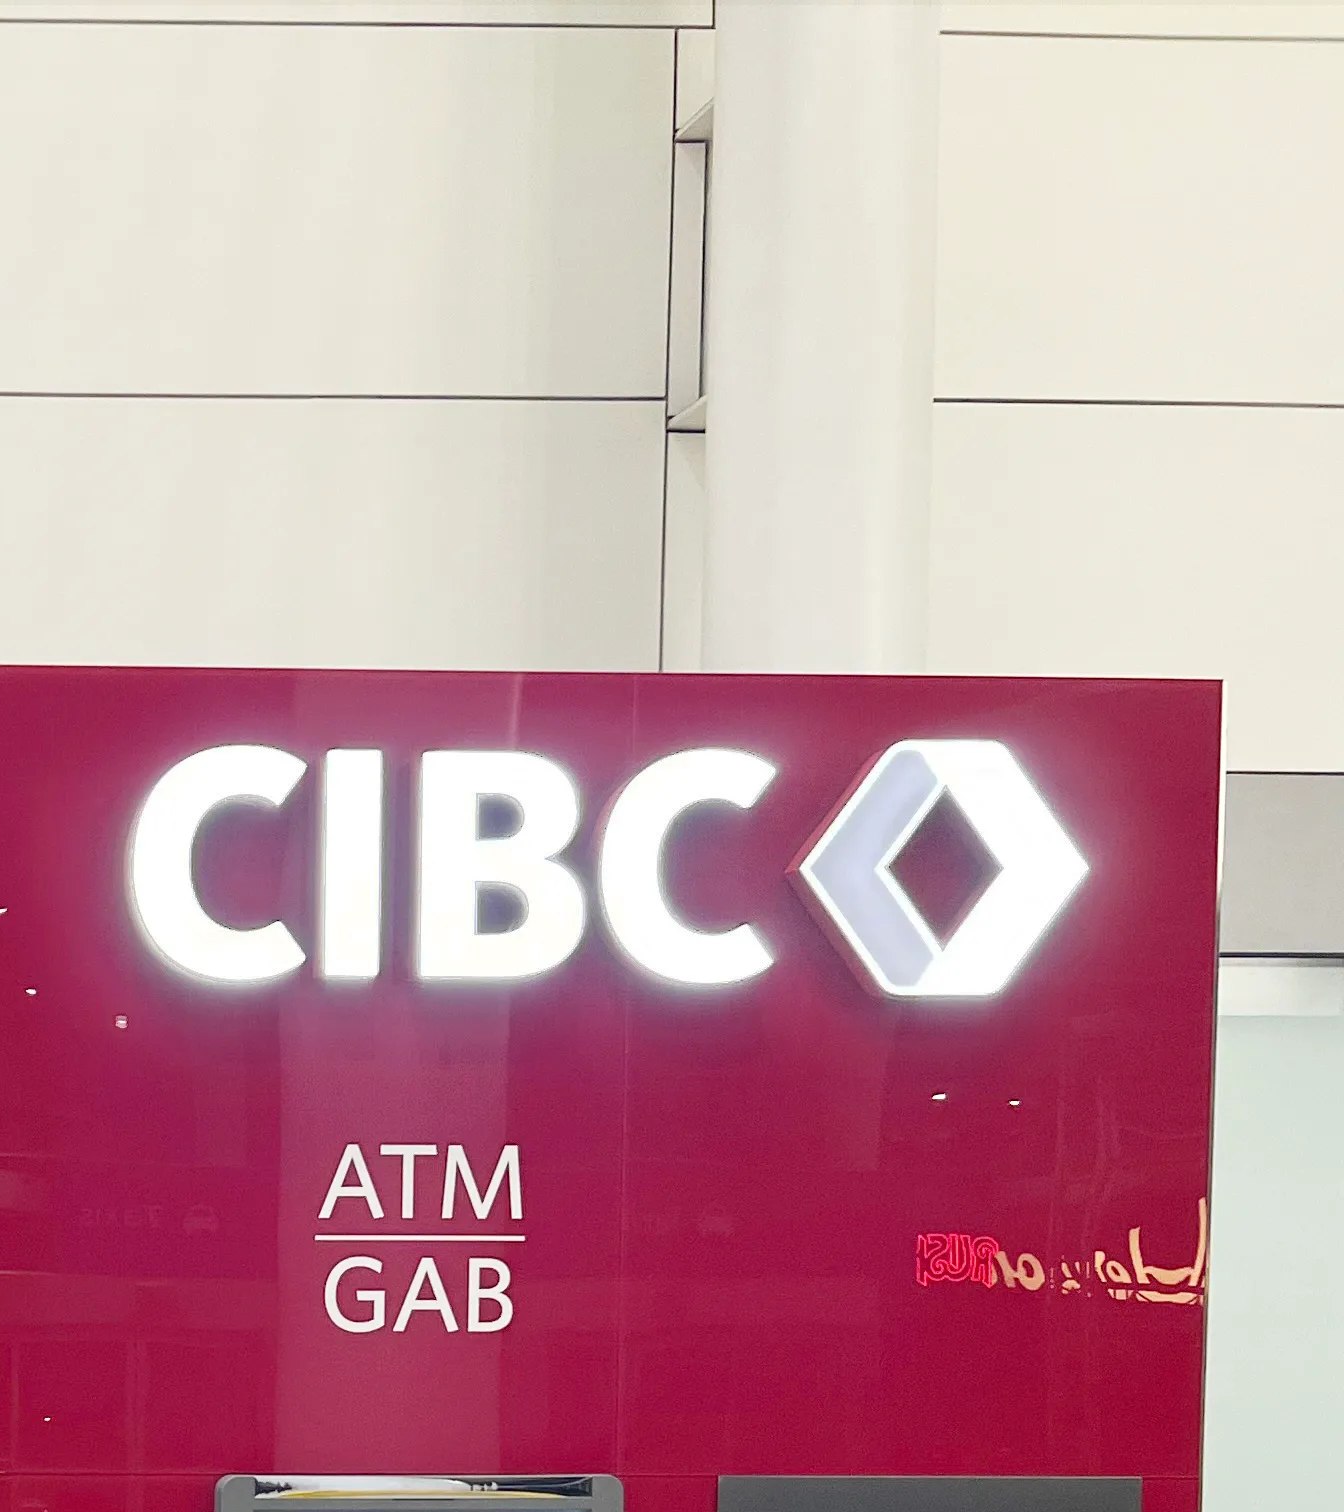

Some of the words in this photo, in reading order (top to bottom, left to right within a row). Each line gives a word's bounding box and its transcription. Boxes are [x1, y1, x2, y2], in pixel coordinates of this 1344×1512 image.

[130, 743, 778, 986] CIBC
[318, 1143, 523, 1220] ATM
[324, 1256, 514, 1333] GAB
